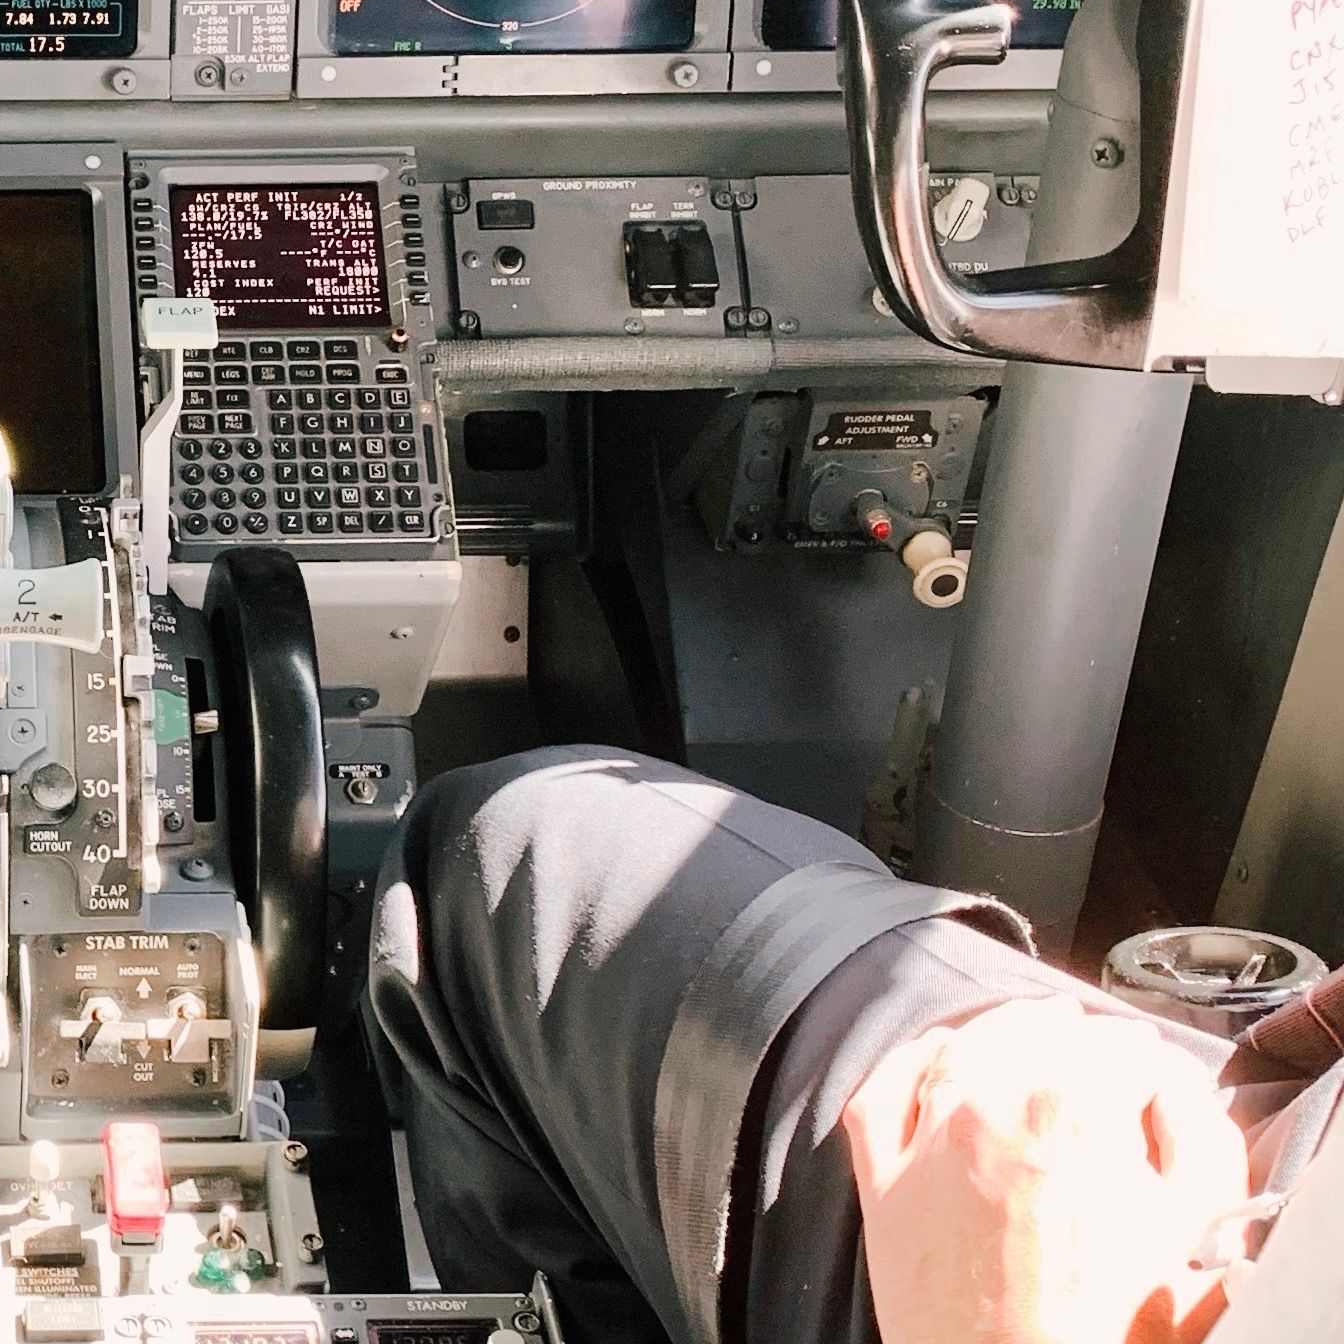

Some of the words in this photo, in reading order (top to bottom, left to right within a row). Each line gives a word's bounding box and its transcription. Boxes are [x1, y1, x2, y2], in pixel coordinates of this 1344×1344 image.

[29, 37, 65, 52] 17.5
[543, 181, 582, 191] GROUND
[585, 180, 637, 190] PROXIMITY
[196, 193, 218, 202] ACT
[227, 193, 258, 202] PERF
[268, 193, 298, 202] INIT
[157, 307, 204, 315] FLAP
[844, 414, 882, 424] RUDDER
[885, 414, 915, 424] PEDAL
[846, 425, 909, 434] ADJUSTMENT
[18, 579, 38, 605] 2
[13, 611, 40, 624] A/T
[87, 726, 111, 743] 25
[82, 780, 111, 797] 30
[29, 831, 59, 842] HORN
[29, 840, 72, 852] CUTOUT
[82, 846, 111, 864] 40
[90, 884, 127, 896] FLAP
[89, 897, 129, 910] DOWN
[86, 936, 123, 950] STAB
[128, 936, 169, 950] TRIM
[119, 966, 160, 976] NORMAL
[407, 1300, 468, 1311] STANDBY
